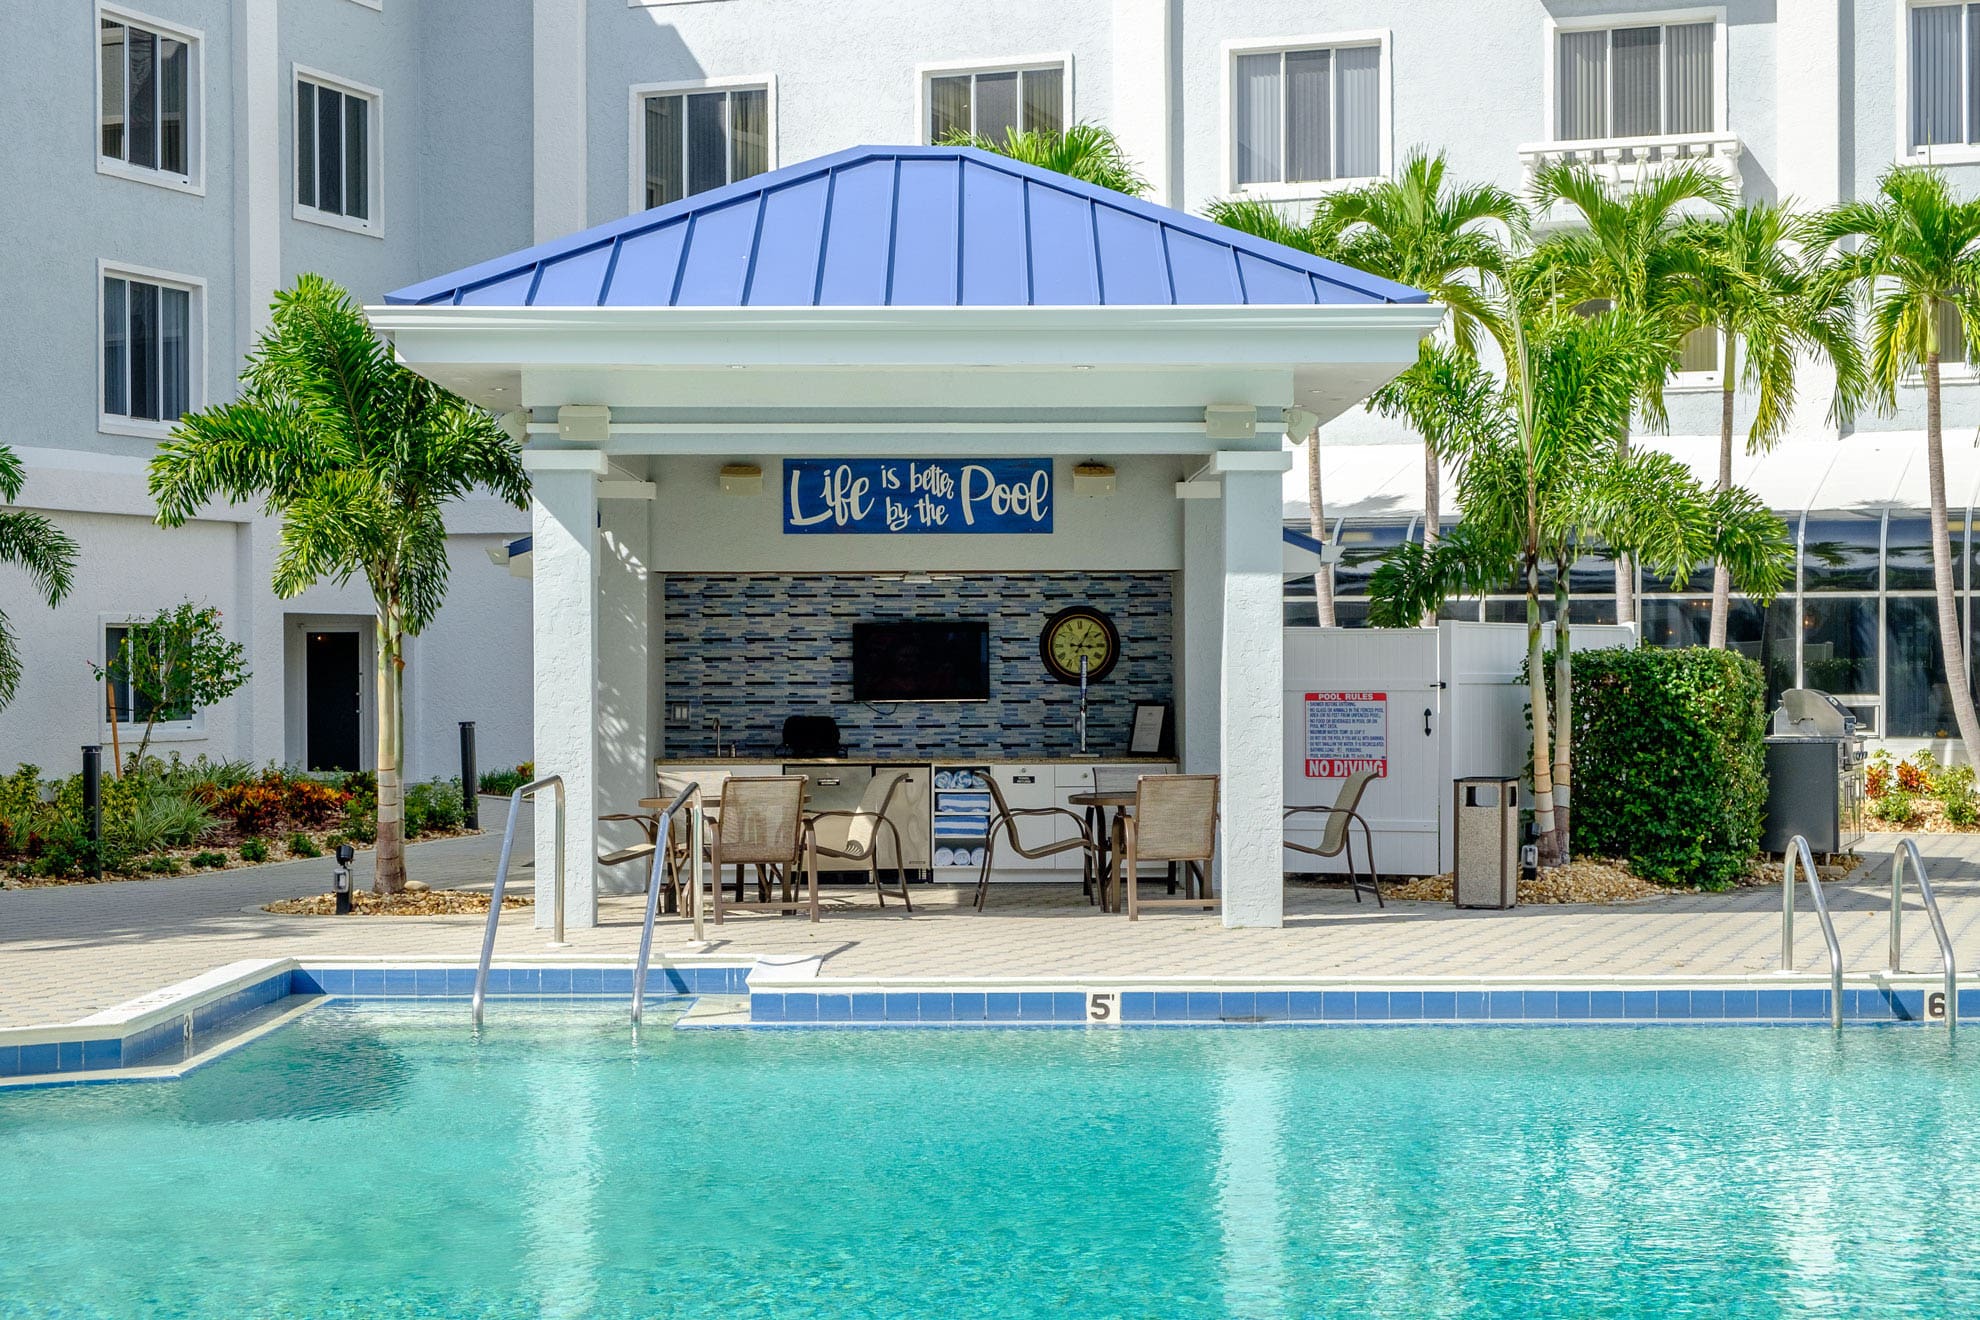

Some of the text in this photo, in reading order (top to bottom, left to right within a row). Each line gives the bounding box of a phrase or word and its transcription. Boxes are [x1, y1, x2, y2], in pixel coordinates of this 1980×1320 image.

[790, 464, 875, 526] Life
[881, 462, 954, 499] is better
[960, 464, 1049, 526] Pool
[886, 494, 949, 532] by the
[1318, 693, 1374, 701] POOL RULES
[1309, 760, 1384, 777] NO DIVING
[1928, 992, 1945, 1018] 6
